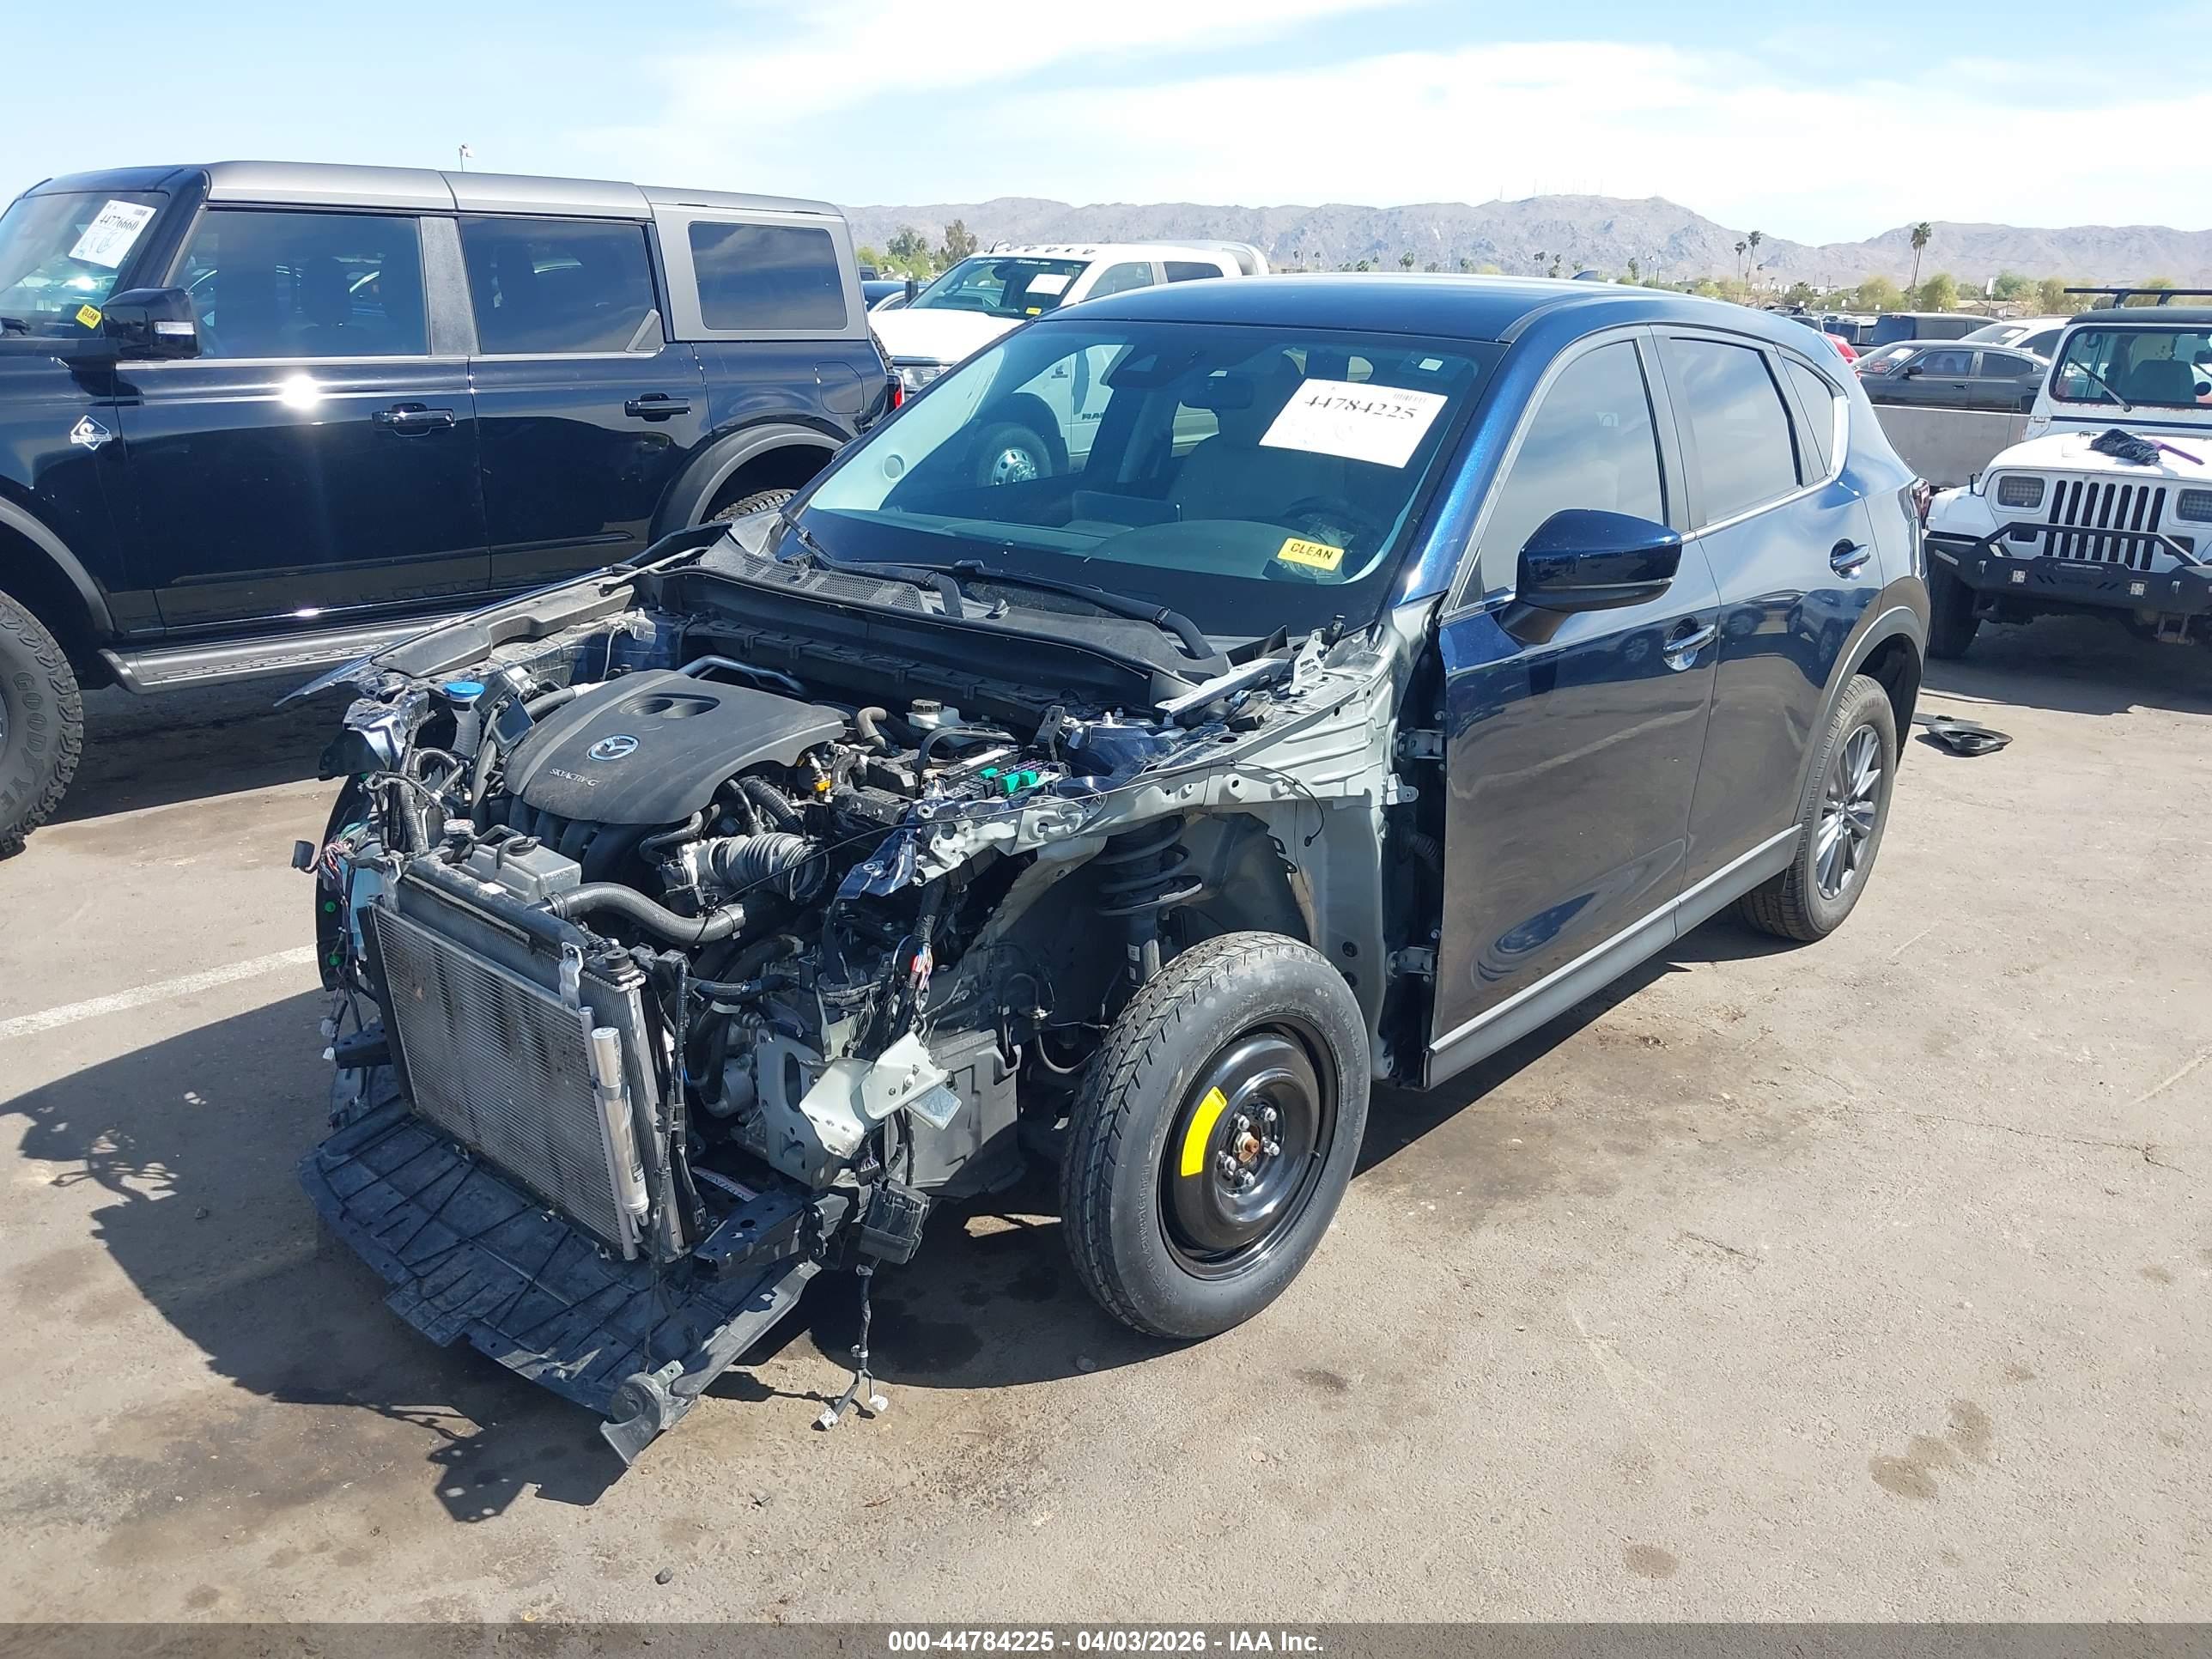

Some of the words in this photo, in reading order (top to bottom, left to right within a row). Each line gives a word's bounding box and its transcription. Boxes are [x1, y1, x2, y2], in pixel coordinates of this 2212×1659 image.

[100, 214, 139, 231] 44776660
[1082, 411, 1104, 420] RA
[1304, 395, 1418, 420] 44784225
[1291, 543, 1334, 560] CLEAN
